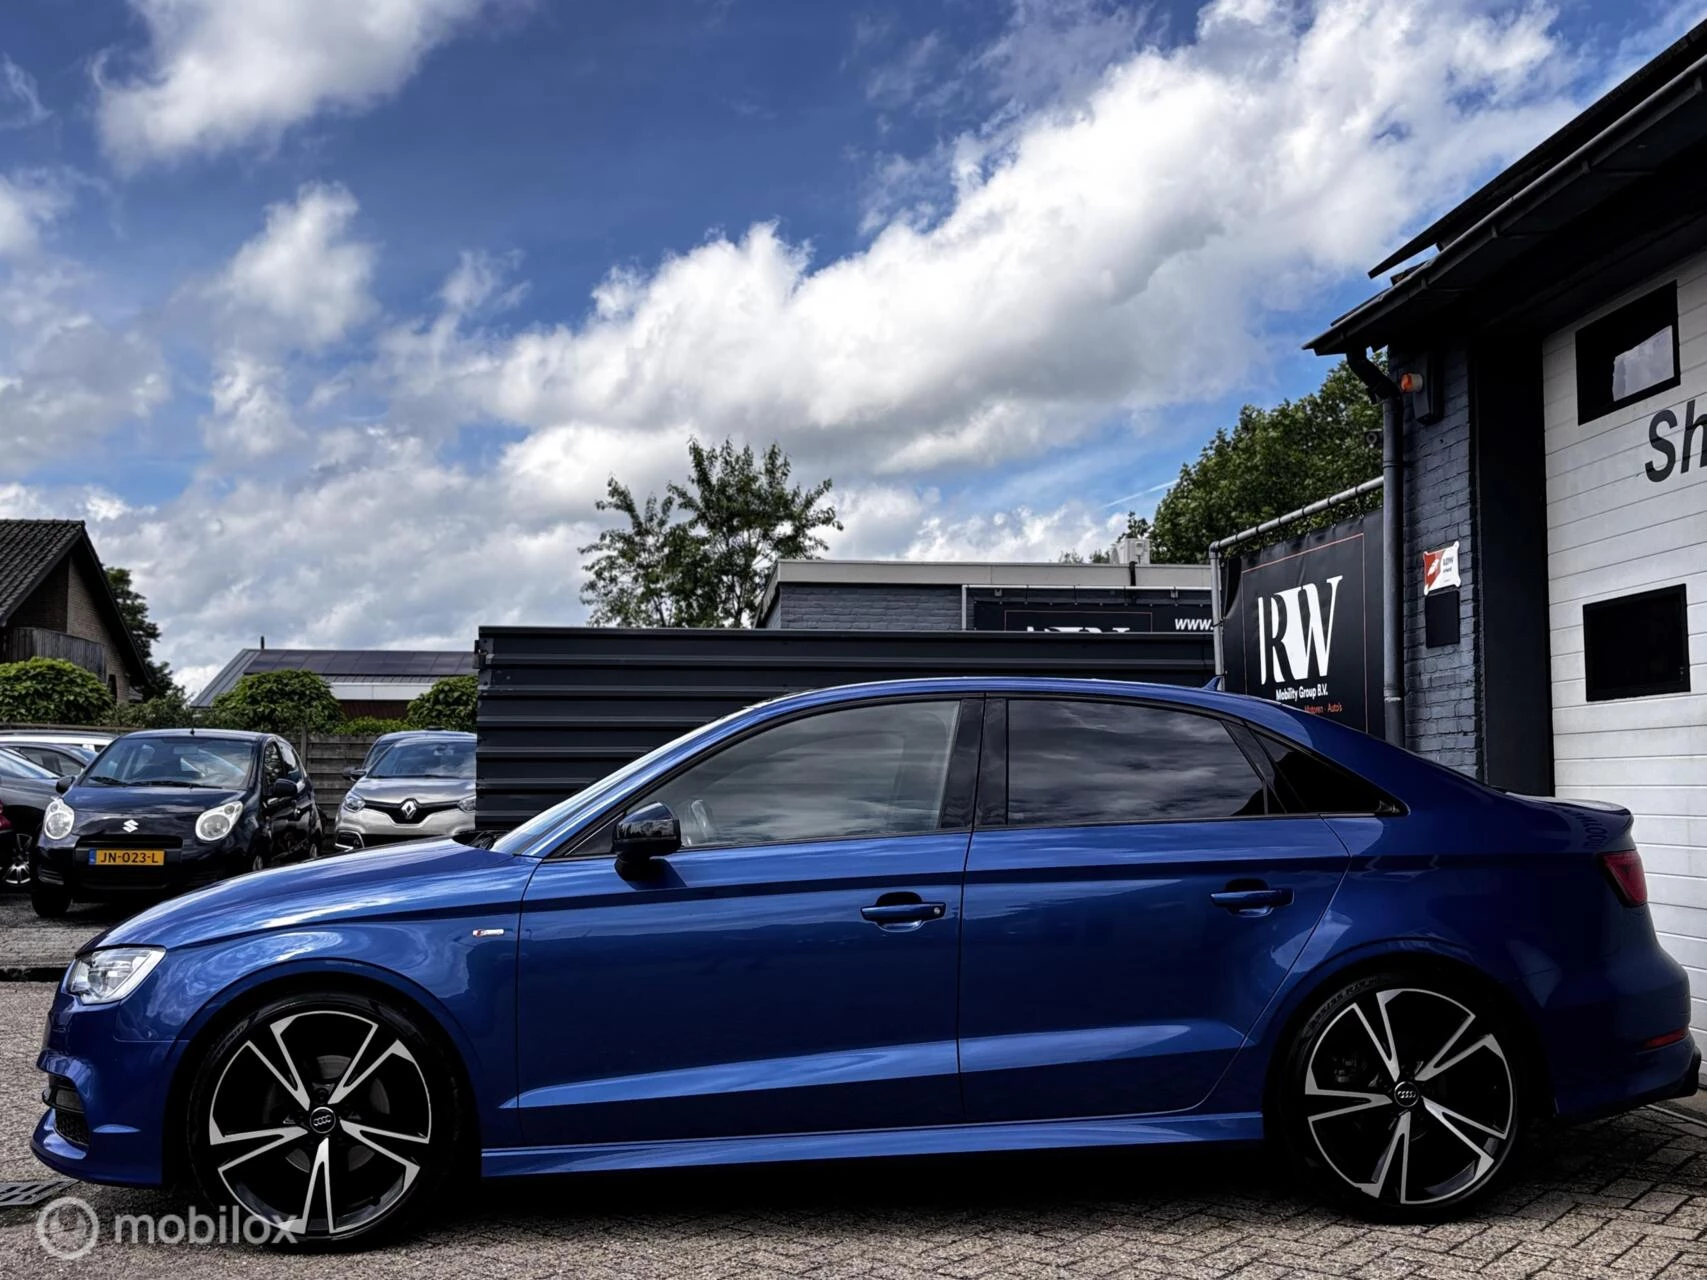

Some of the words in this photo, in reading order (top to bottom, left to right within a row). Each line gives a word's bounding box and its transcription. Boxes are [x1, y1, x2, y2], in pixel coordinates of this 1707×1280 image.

[1645, 399, 1707, 482] Sh
[1258, 575, 1343, 685] RW
[1275, 687, 1298, 702] Mobility
[1298, 685, 1317, 700] Group
[1317, 683, 1329, 696] B.V.
[100, 852, 159, 863] JN-023-L
